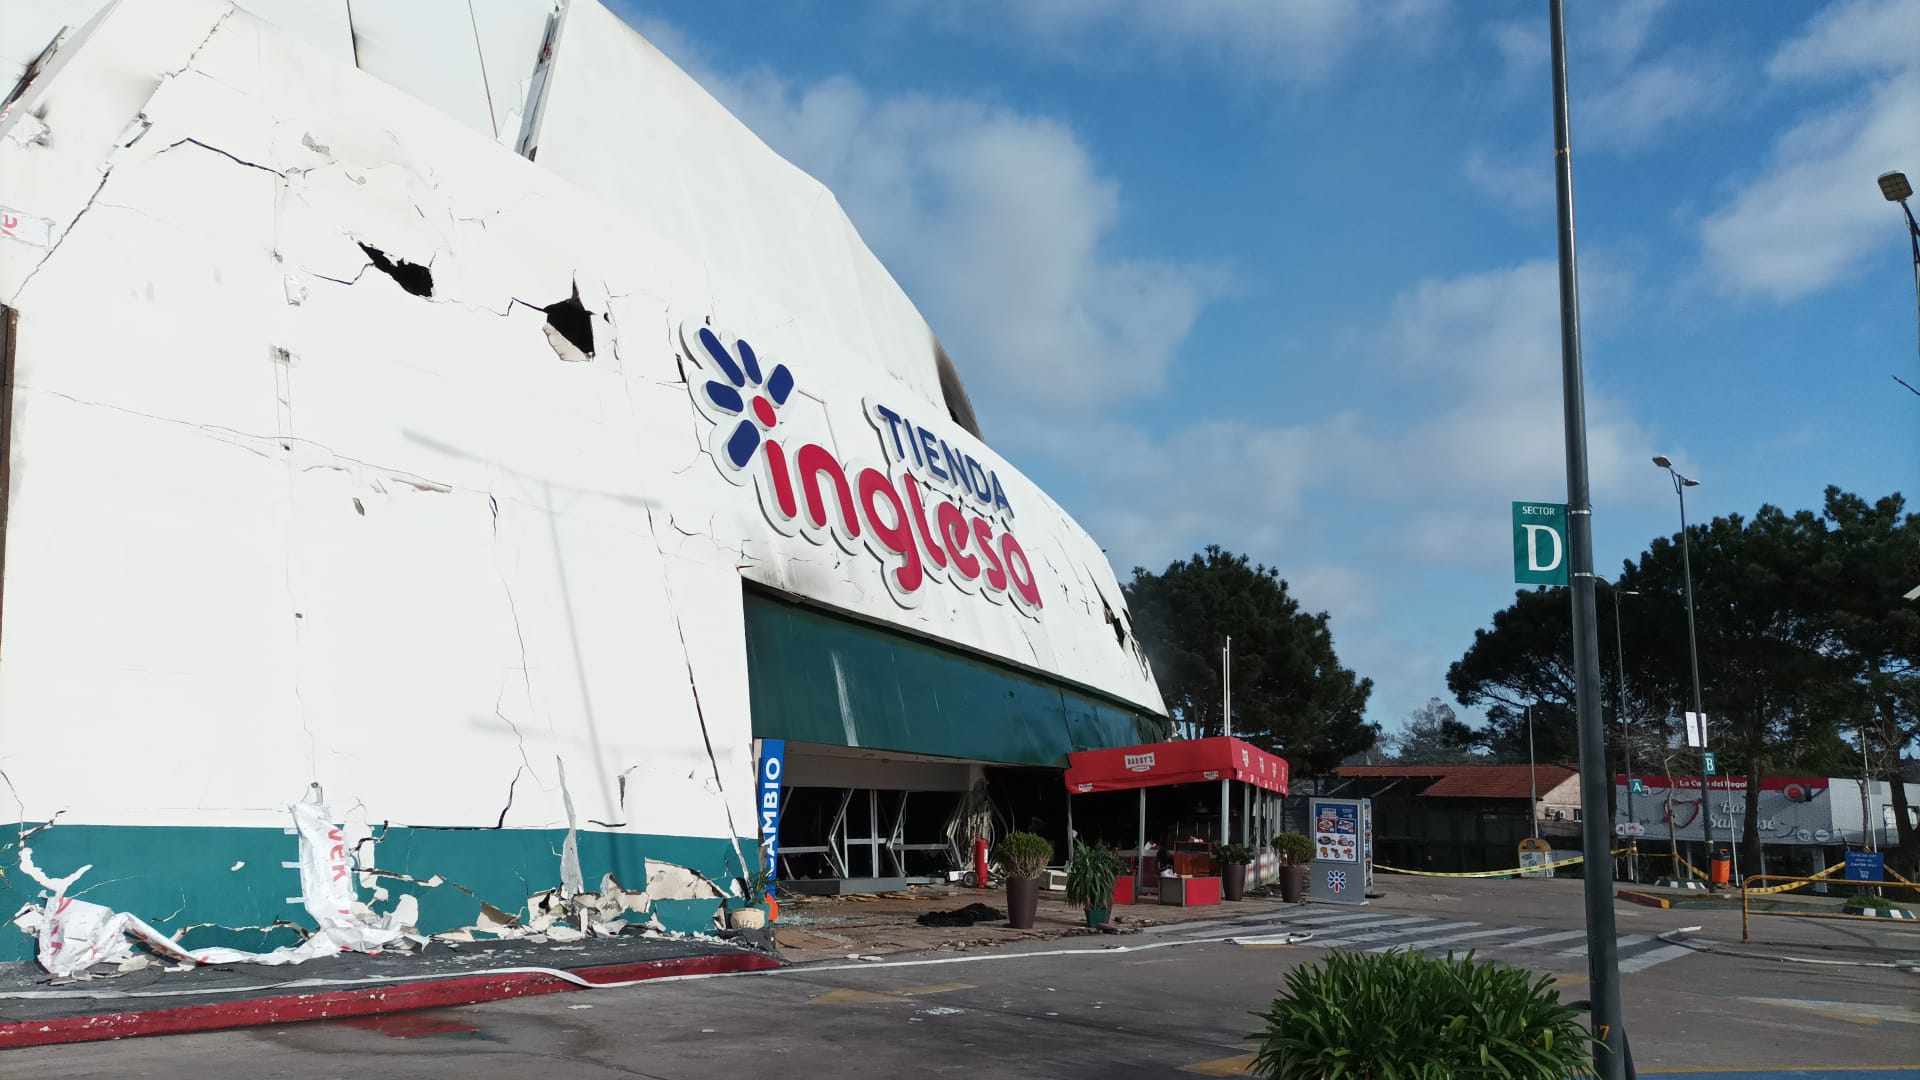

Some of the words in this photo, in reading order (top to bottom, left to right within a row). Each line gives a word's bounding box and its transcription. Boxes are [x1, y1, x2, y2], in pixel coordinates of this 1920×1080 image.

[877, 403, 1015, 519] TIENDA
[1522, 506, 1556, 516] SECTOR
[764, 439, 1043, 609] inglesa
[1521, 523, 1563, 572] D
[1705, 757, 1714, 771] B
[1633, 782, 1642, 793] A
[1711, 780, 1724, 788] del
[1725, 780, 1748, 789] Regal
[1710, 812, 1737, 829] San
